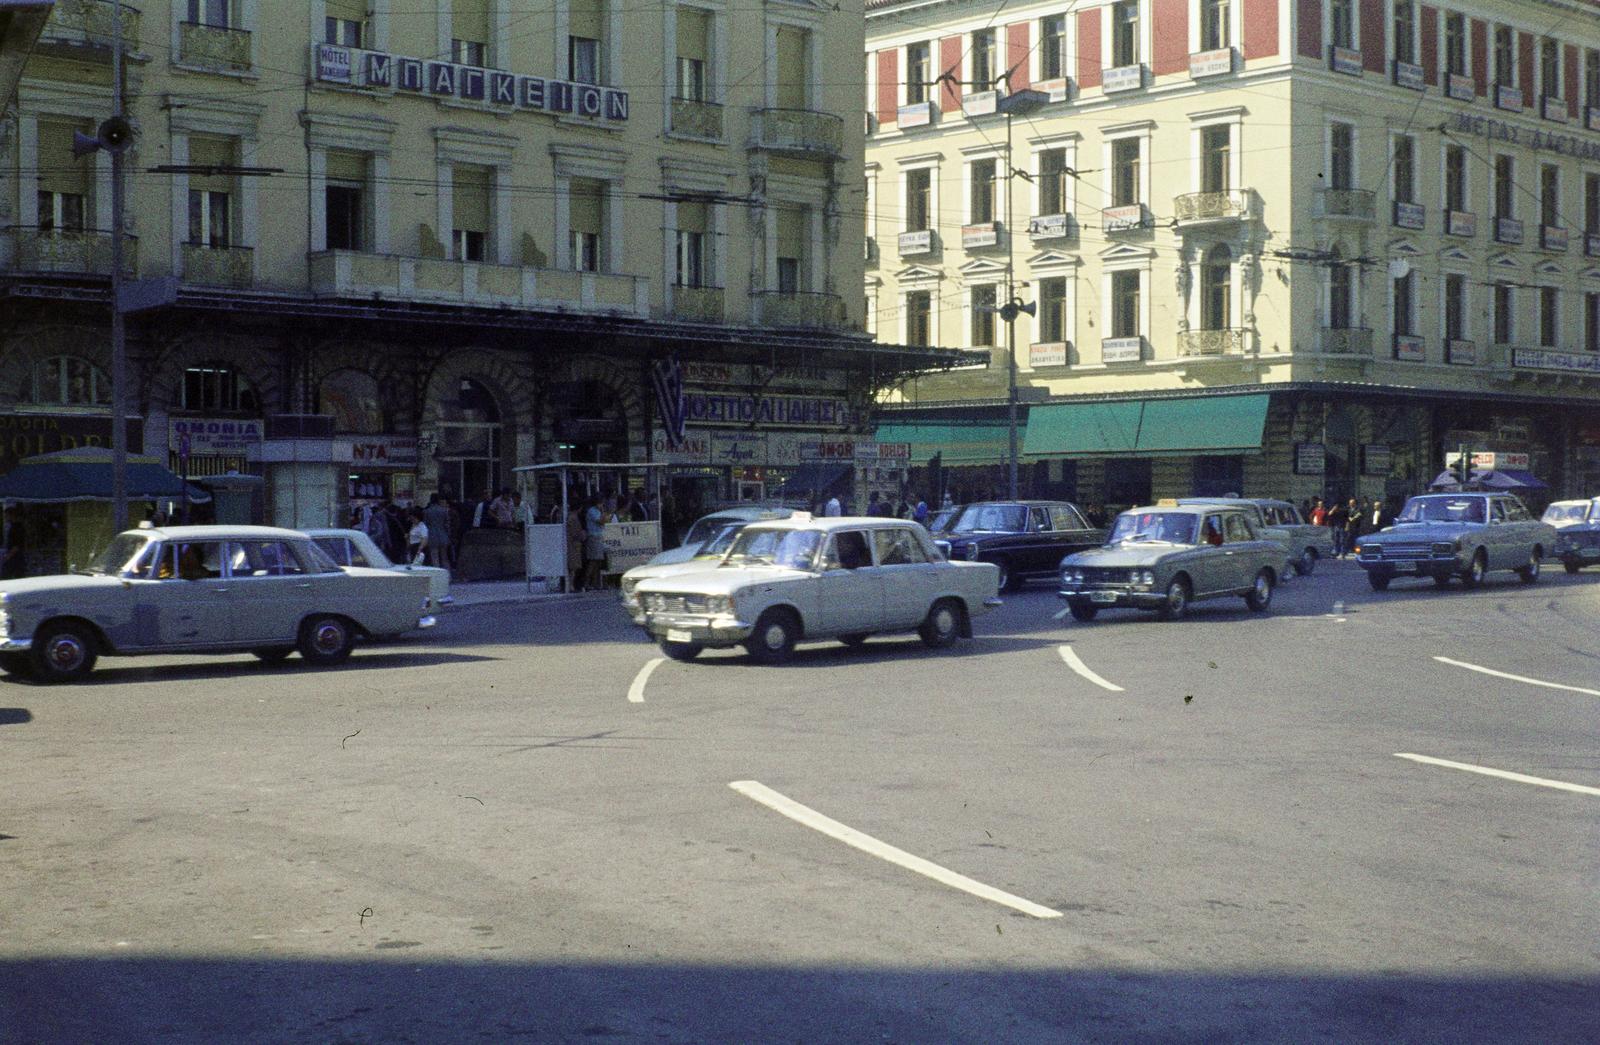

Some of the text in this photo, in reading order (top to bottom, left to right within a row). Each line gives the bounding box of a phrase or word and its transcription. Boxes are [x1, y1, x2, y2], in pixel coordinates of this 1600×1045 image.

[321, 49, 349, 65] HOTEL
[369, 53, 628, 120] ΜΠΑΓΚΕΙΟΝ
[620, 526, 640, 537] TAXI
